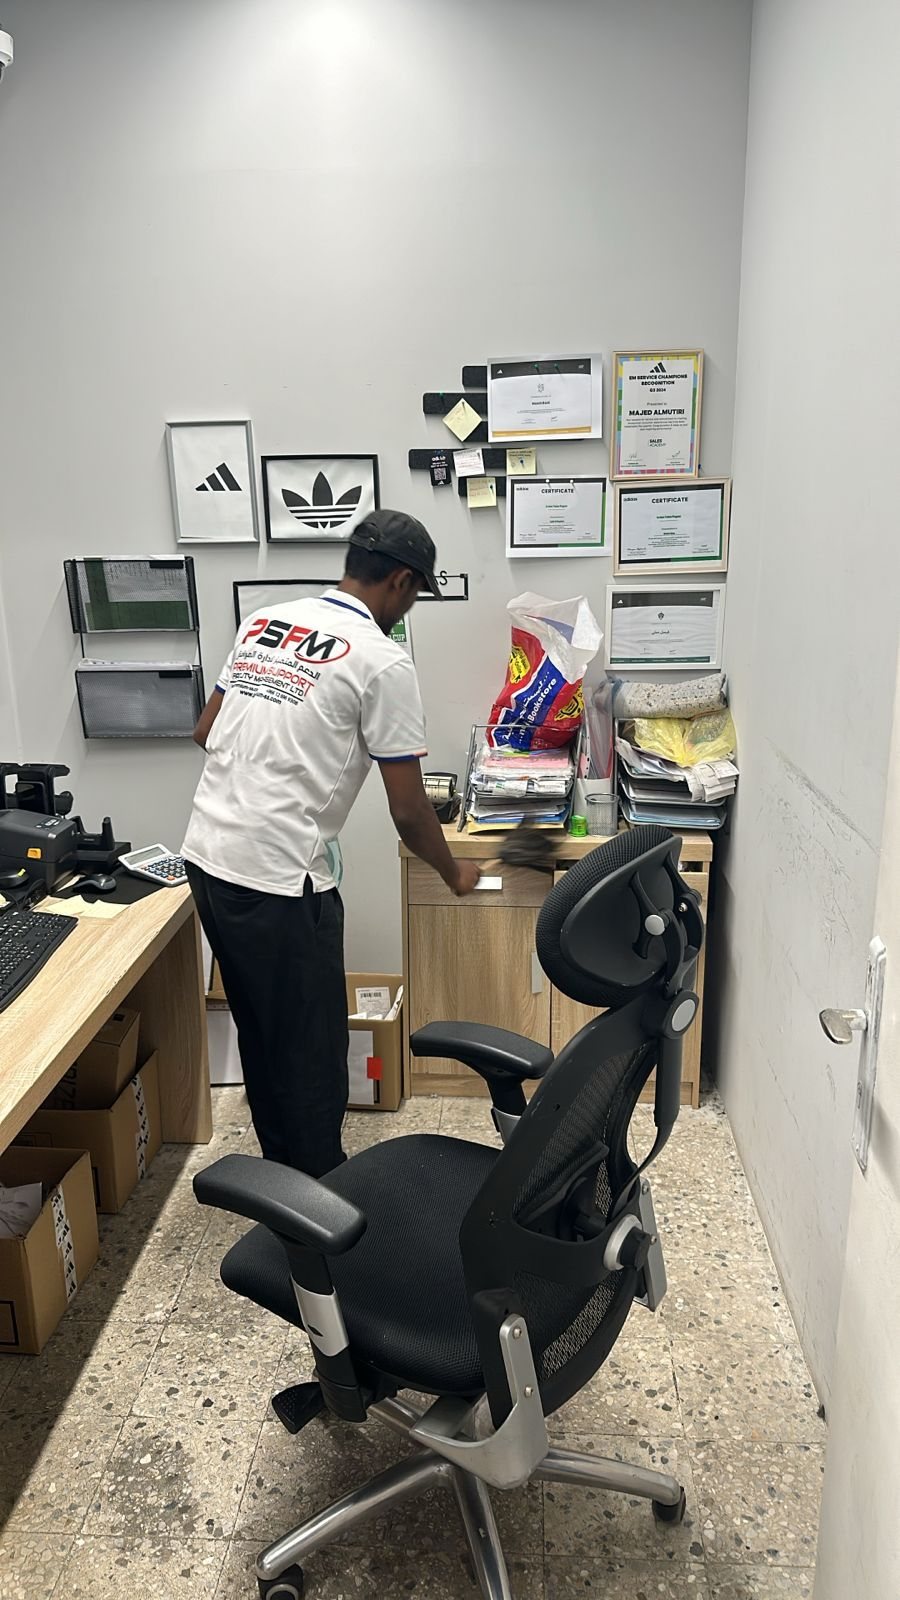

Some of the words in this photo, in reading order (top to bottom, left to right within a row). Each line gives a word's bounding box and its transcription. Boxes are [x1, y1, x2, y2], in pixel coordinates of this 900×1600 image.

[651, 496, 688, 504] CERTIFICATE
[241, 618, 337, 661] PSFM
[296, 664, 321, 680] الدعم
[289, 687, 304, 697] LTD
[527, 678, 557, 722] Bookstore
